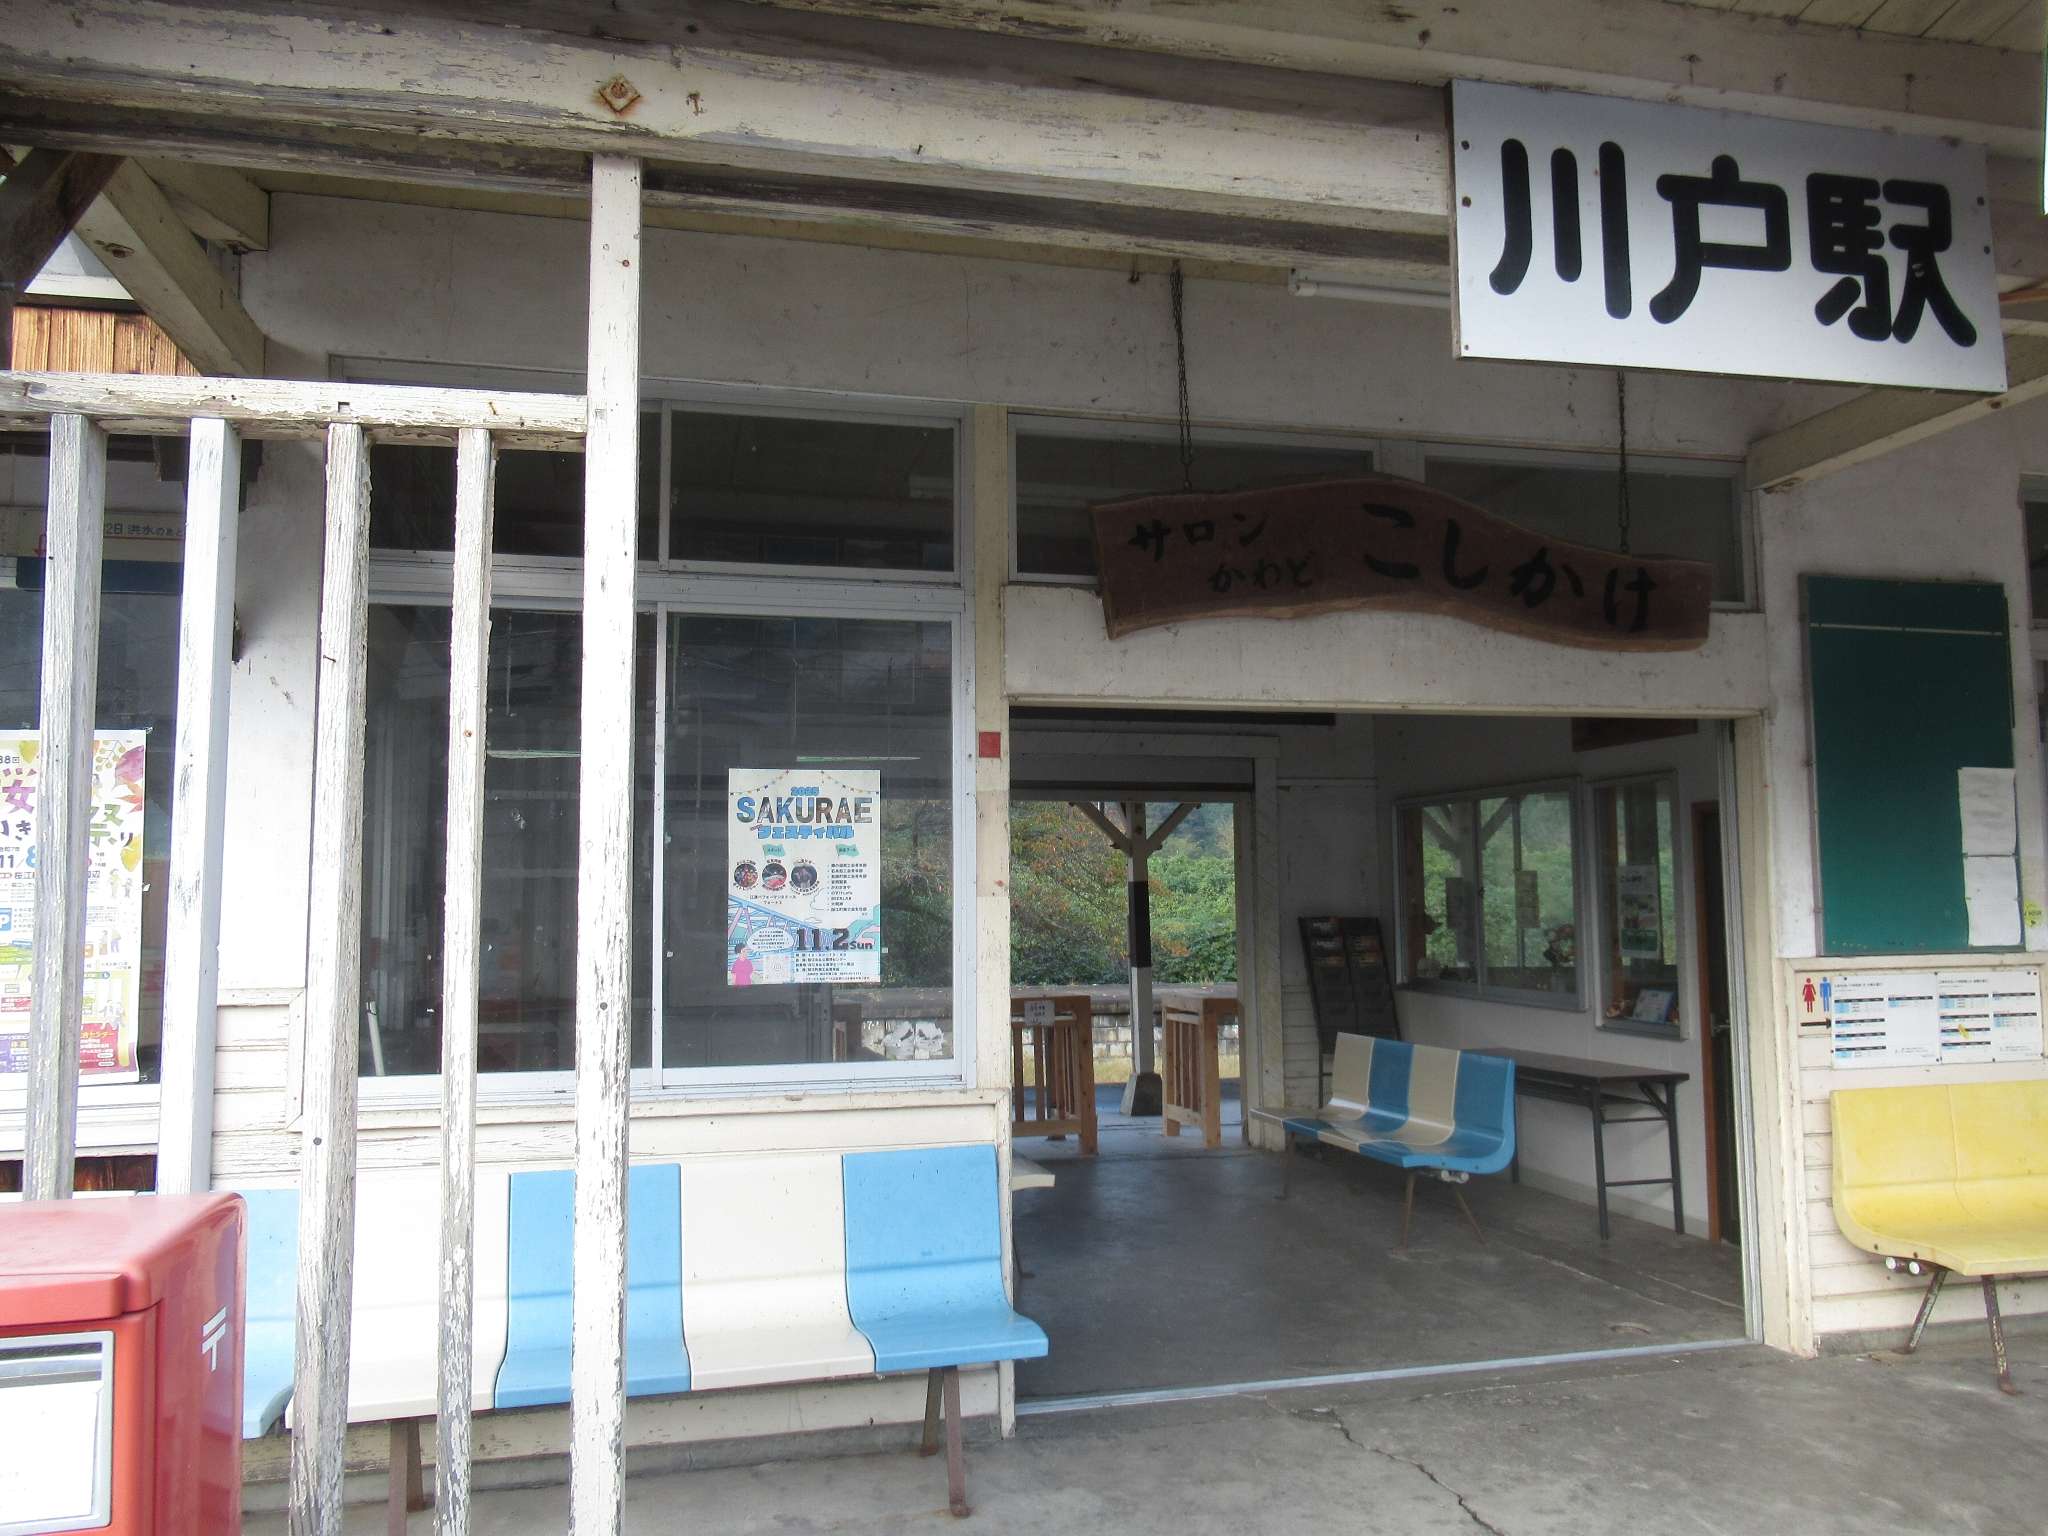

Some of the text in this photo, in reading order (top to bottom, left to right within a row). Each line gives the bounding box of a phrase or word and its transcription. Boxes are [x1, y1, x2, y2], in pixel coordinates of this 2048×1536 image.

[1489, 137, 1977, 347] 川戸駅
[1128, 511, 1269, 562] サロン
[1362, 503, 1658, 634] こしかけ
[736, 796, 873, 824] SAKURAE
[757, 825, 855, 840] フェスティバル
[796, 927, 849, 951] 11.2
[850, 940, 873, 950] Sun
